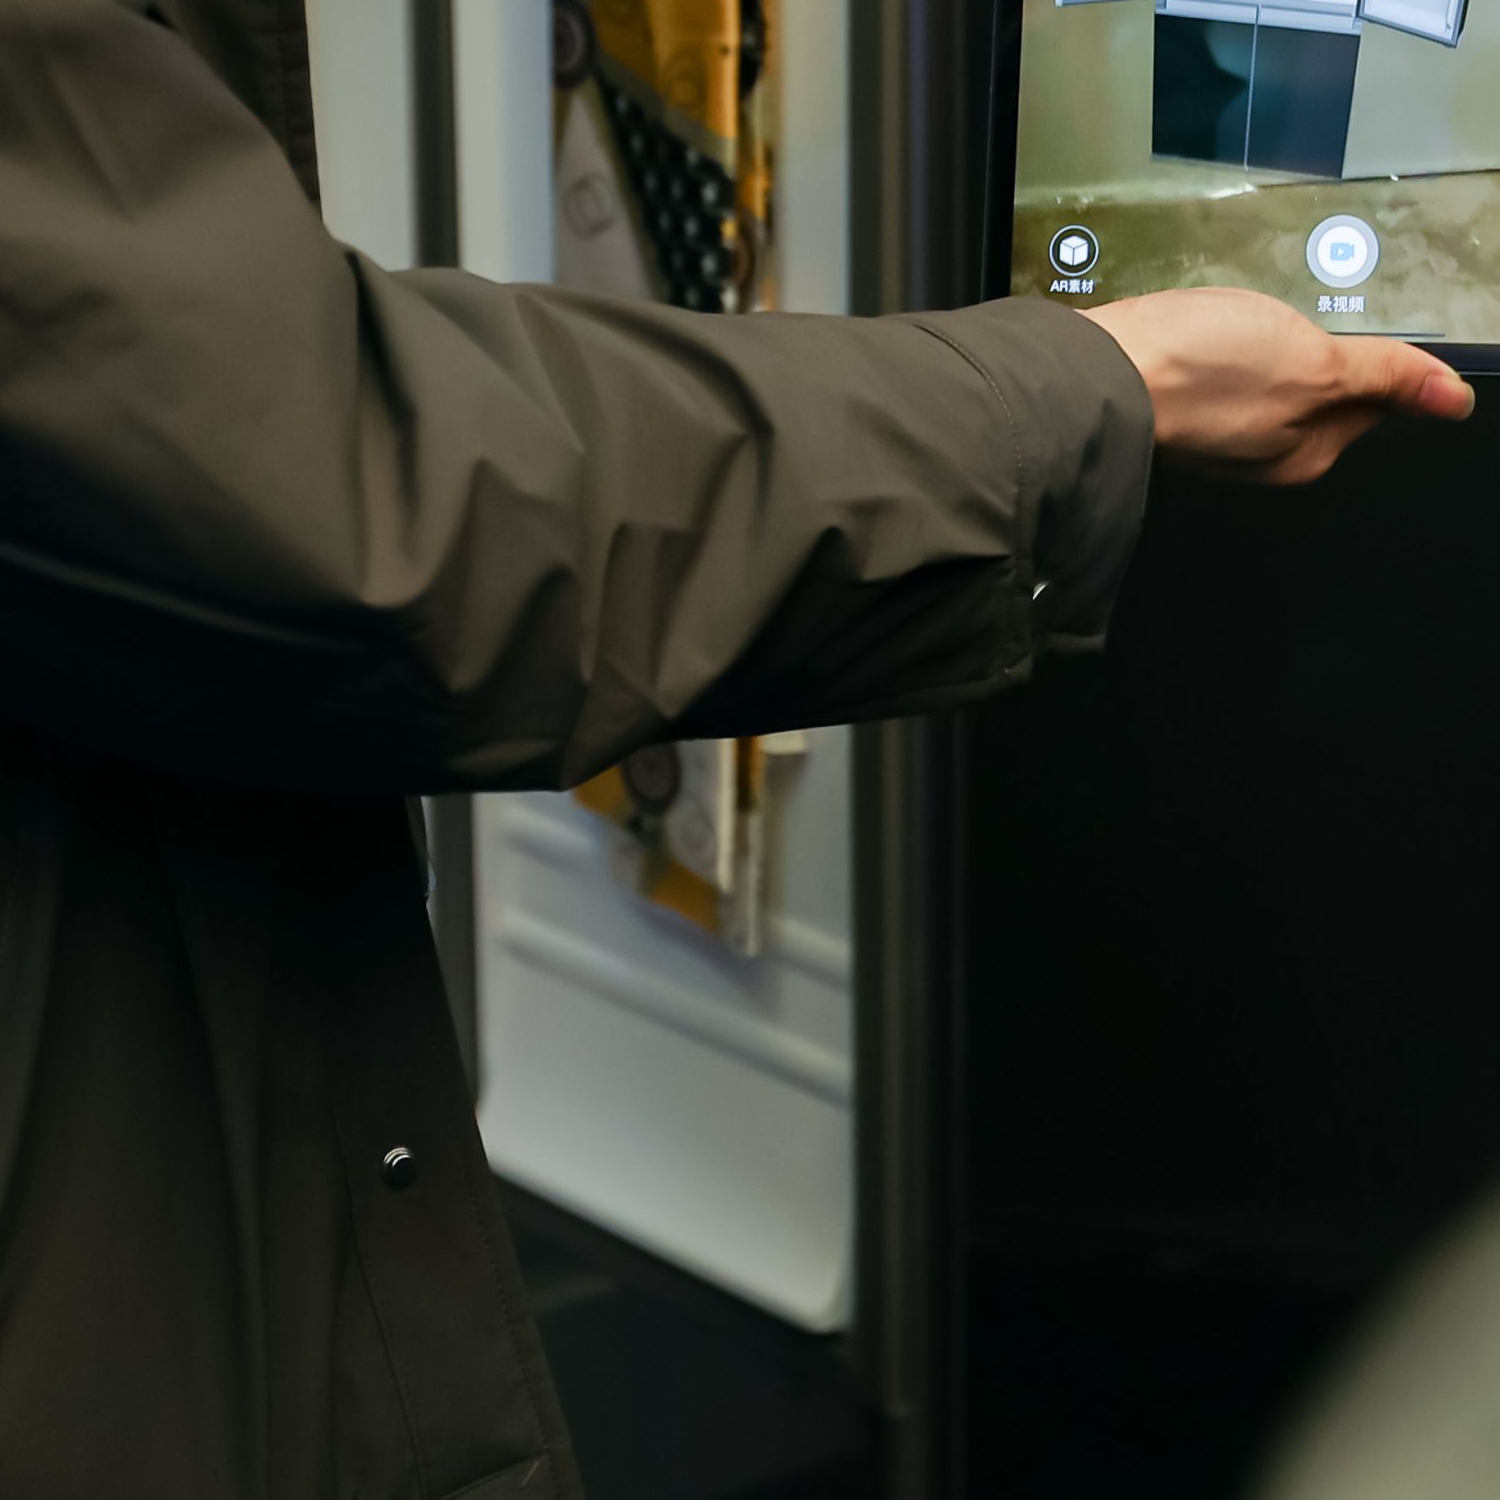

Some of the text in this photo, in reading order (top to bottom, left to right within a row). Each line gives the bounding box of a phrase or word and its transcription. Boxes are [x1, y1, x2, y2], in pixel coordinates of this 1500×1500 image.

[1050, 279, 1095, 294] AR素材
[1317, 295, 1366, 313] 录视频
